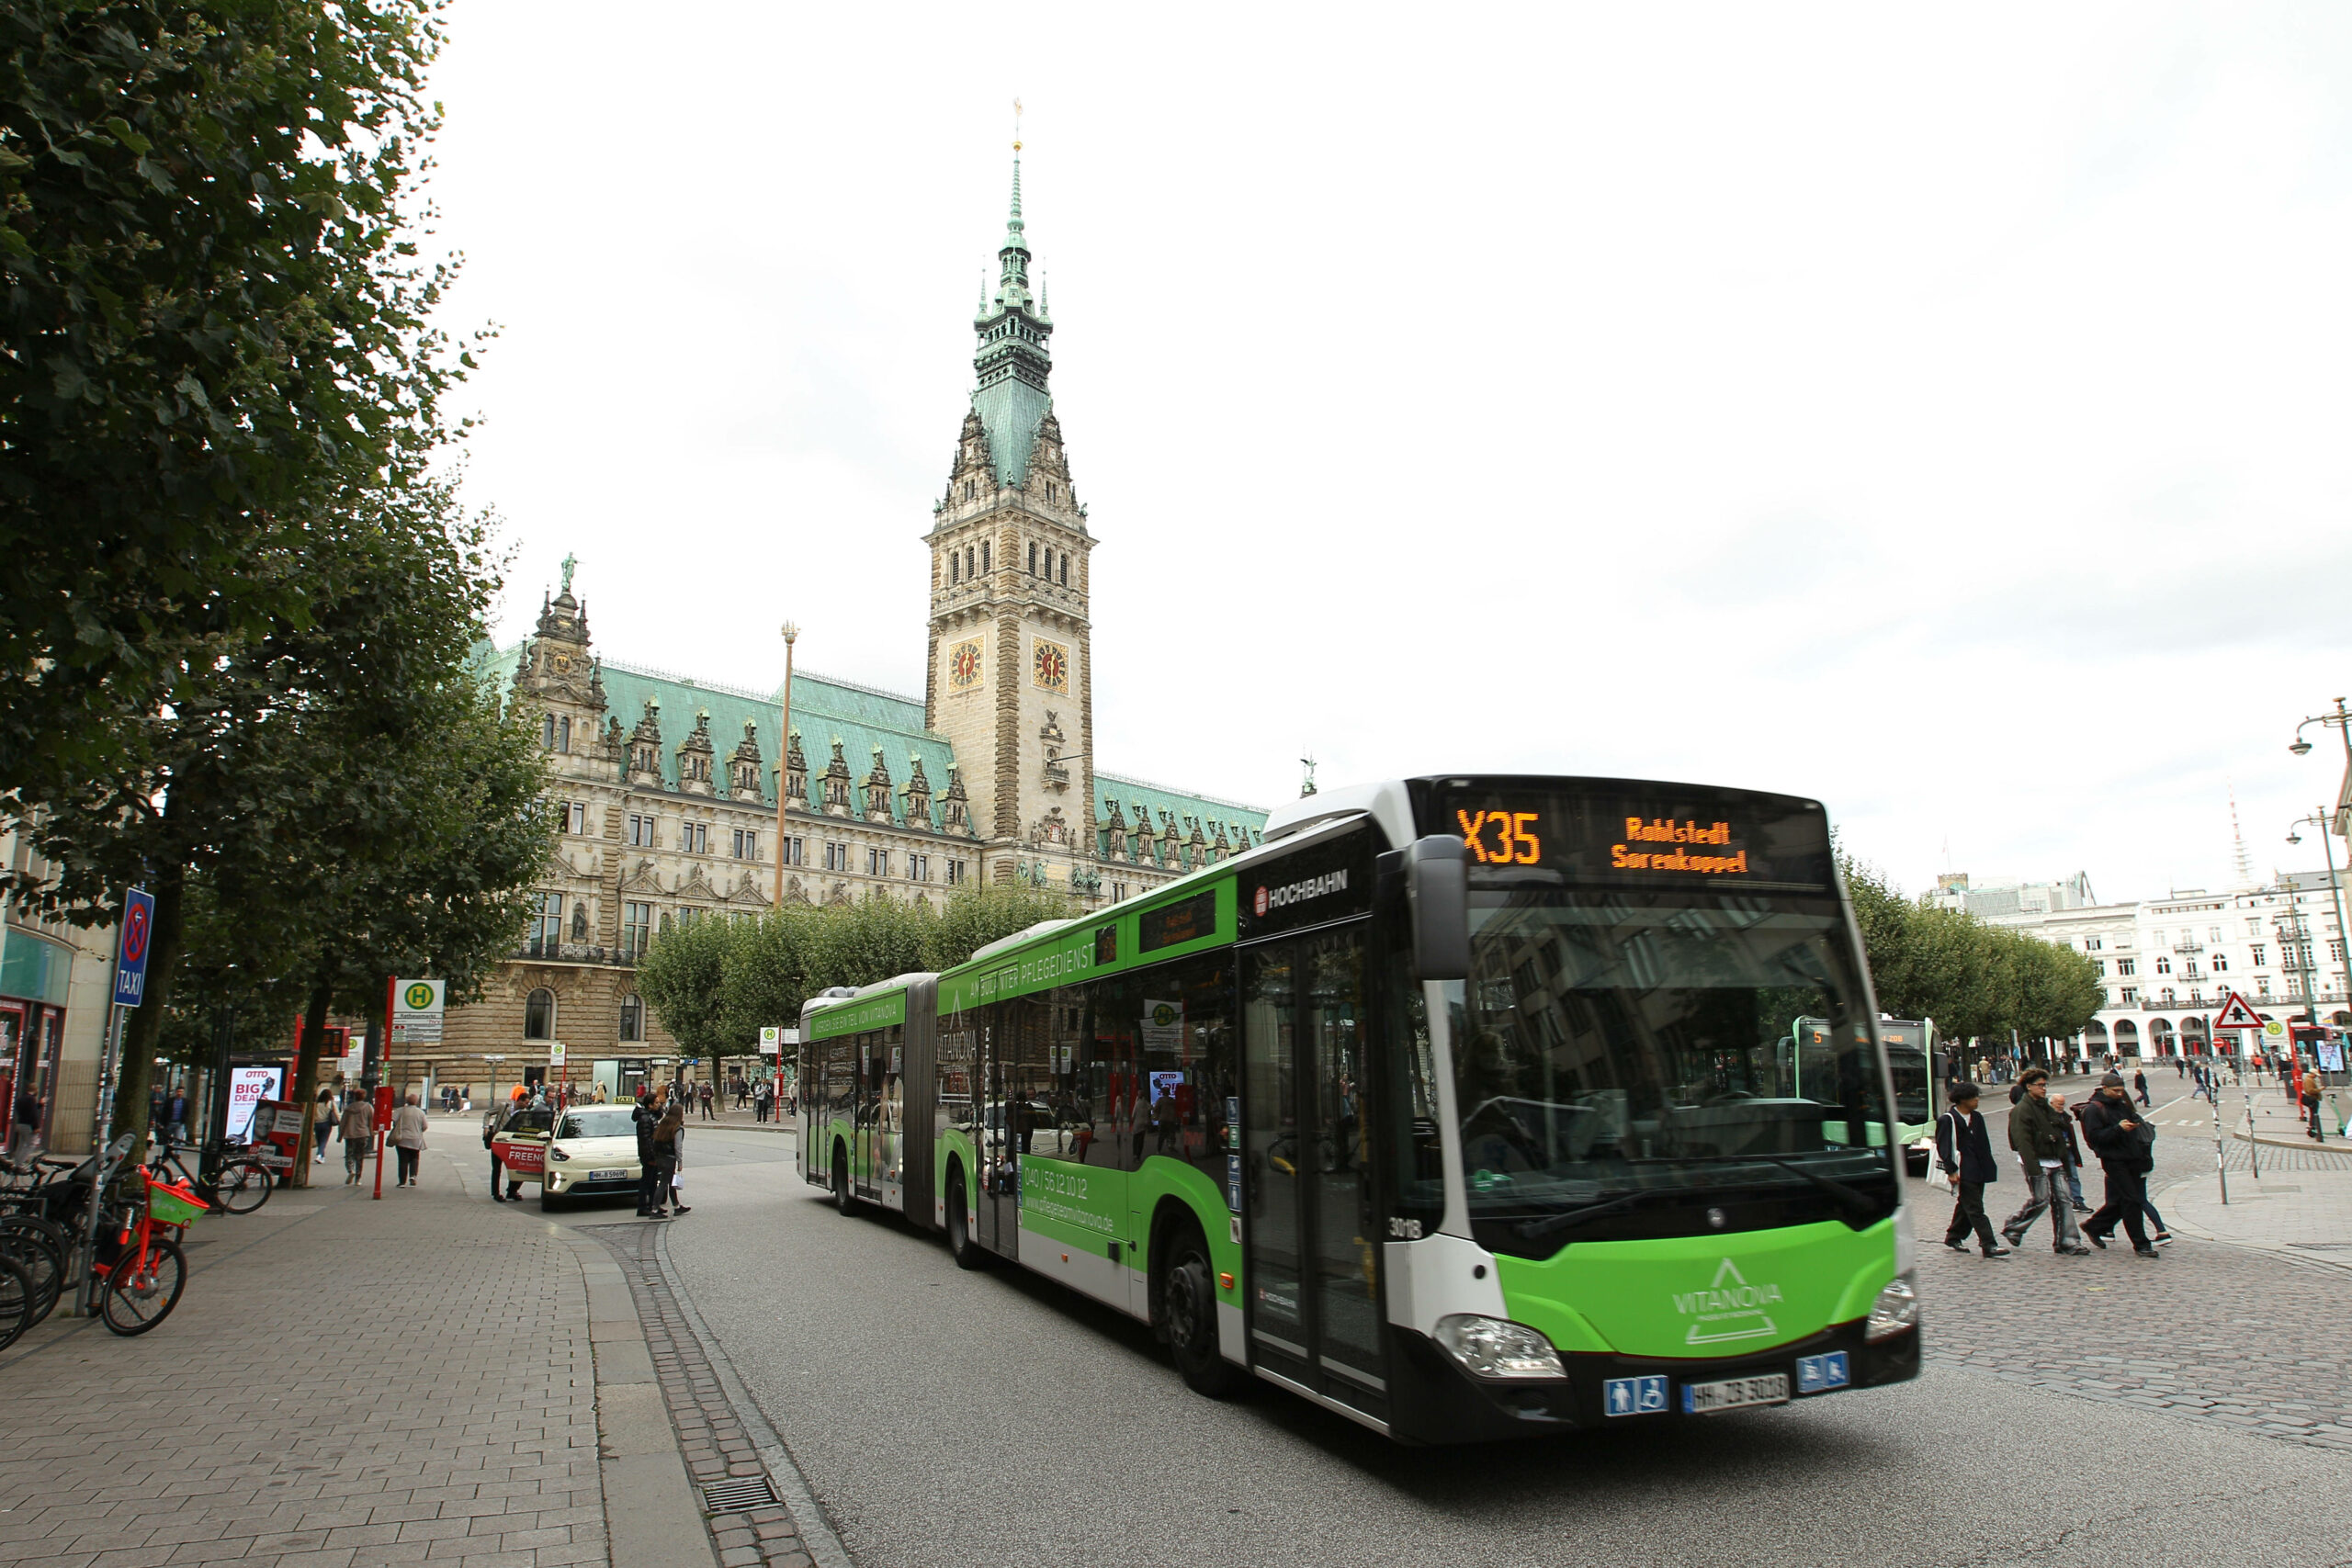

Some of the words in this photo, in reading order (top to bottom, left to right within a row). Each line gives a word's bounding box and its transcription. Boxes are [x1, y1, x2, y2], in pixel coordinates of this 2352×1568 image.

[1457, 809, 1540, 864] X35
[1625, 817, 1730, 845] Rahlstedt
[1269, 869, 1348, 908] HOCHBAHN
[1022, 942, 1095, 986] PFLEGEDIENST
[119, 970, 141, 995] TAXI
[413, 989, 426, 1003] H
[848, 1013, 858, 1026] TEIL
[870, 1003, 897, 1022] VITANOVA
[937, 1030, 977, 1061] VITANOVA
[1814, 1031, 1823, 1043] 5
[1888, 1034, 1904, 1043] ZOB
[245, 1070, 268, 1078] OTTO
[235, 1084, 260, 1094] BIG
[1024, 1167, 1039, 1189] 040
[1044, 1170, 1055, 1191] 56
[1057, 1173, 1065, 1194] 12
[1066, 1176, 1076, 1197] 10
[1078, 1179, 1088, 1200] 12
[1672, 1284, 1784, 1314] VITANOVA
